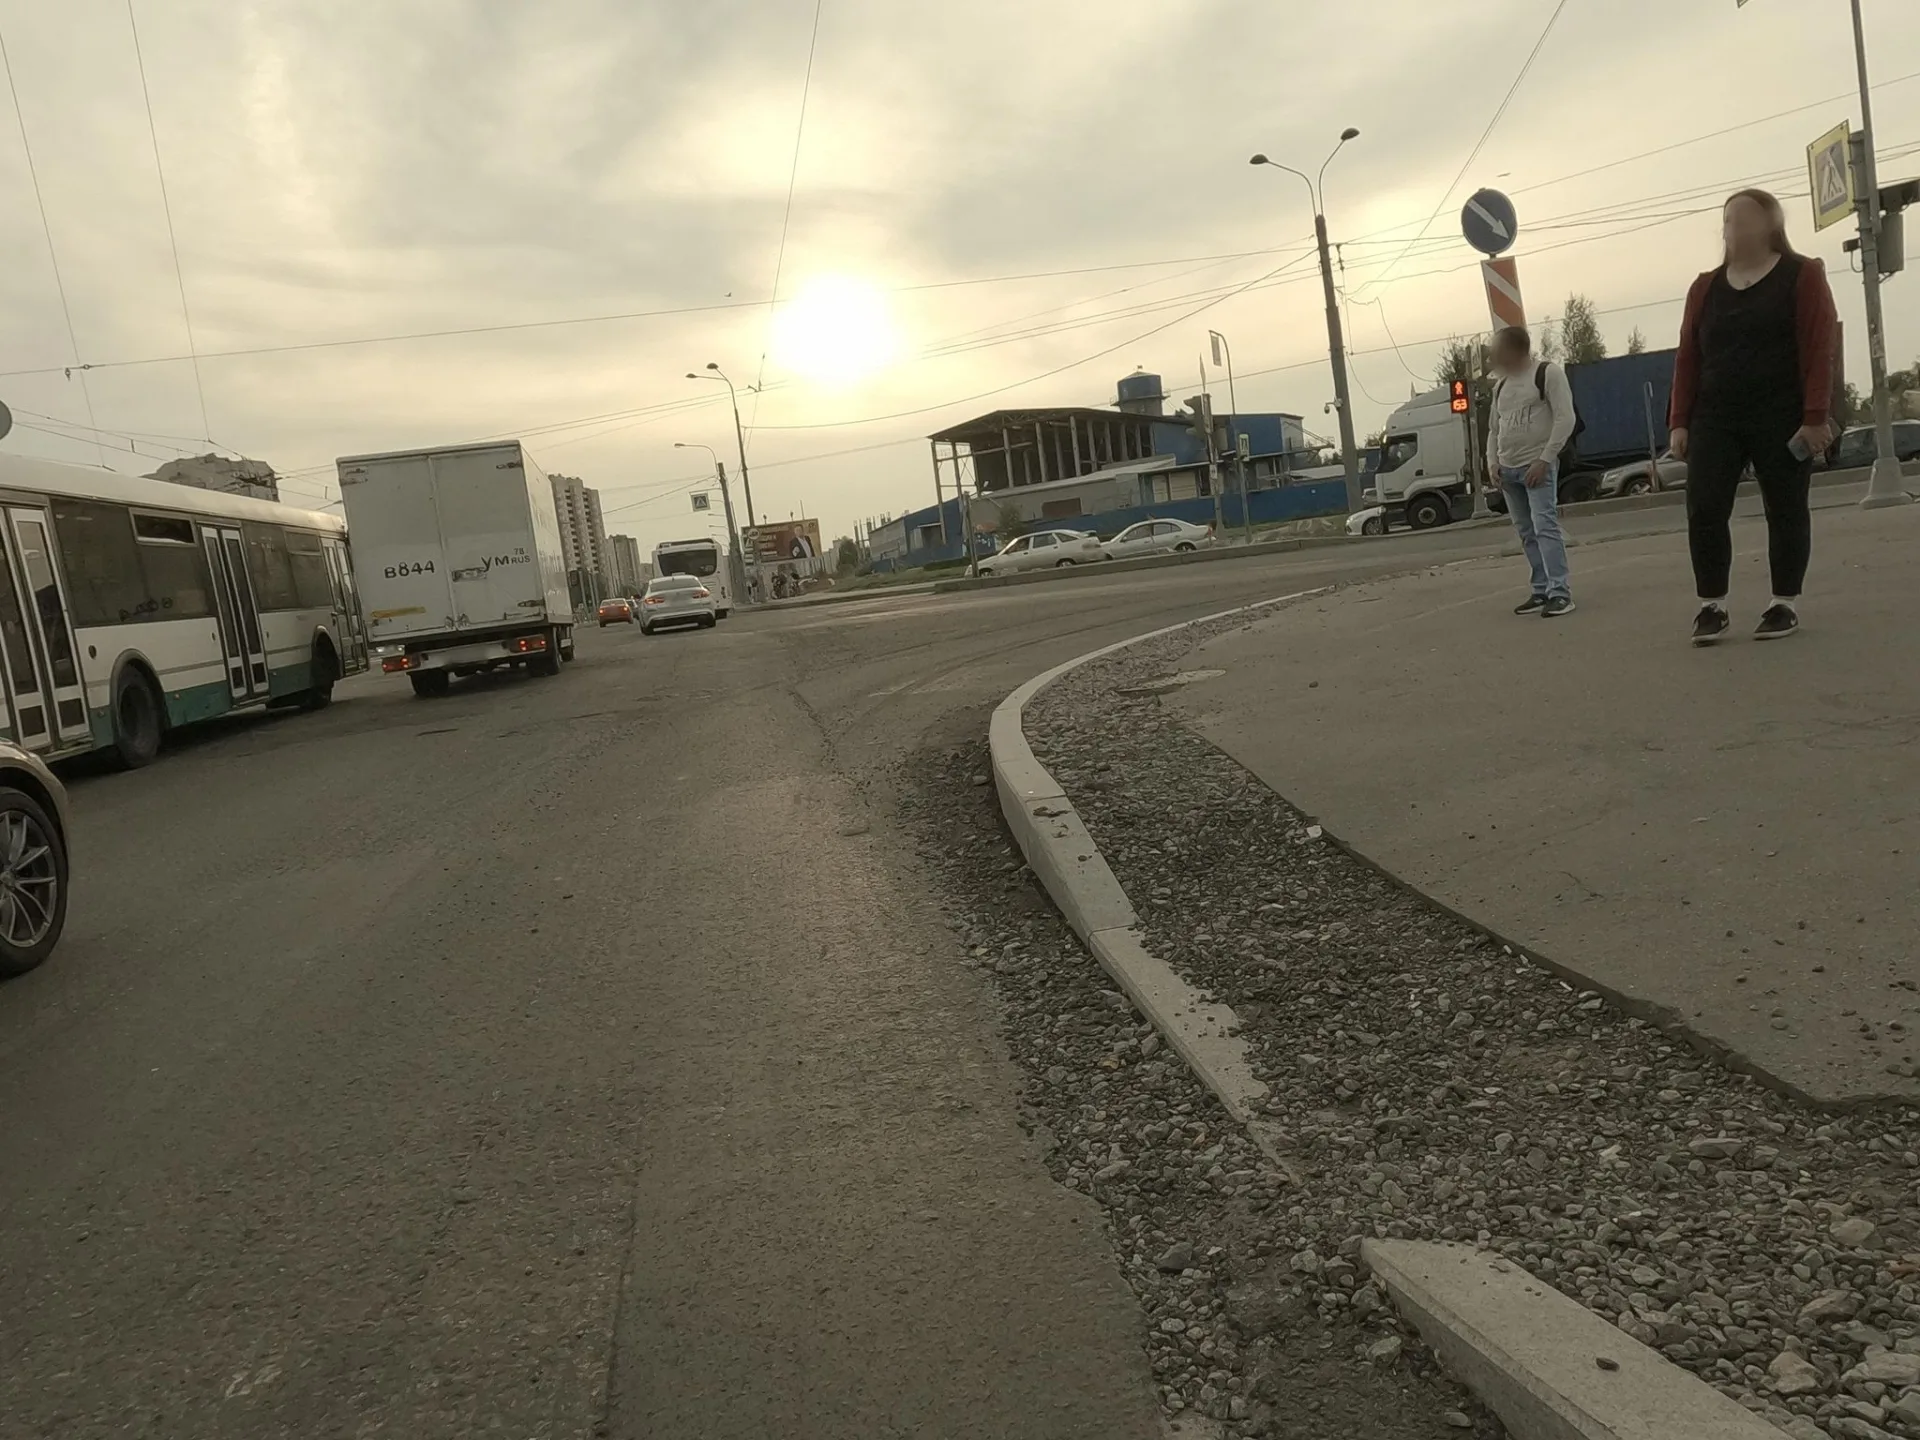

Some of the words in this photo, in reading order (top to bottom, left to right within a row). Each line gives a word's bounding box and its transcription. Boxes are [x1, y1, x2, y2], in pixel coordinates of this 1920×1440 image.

[1453, 399, 1467, 410] 63
[513, 547, 525, 555] 78
[511, 555, 531, 564] RUS
[384, 560, 435, 578] В844
